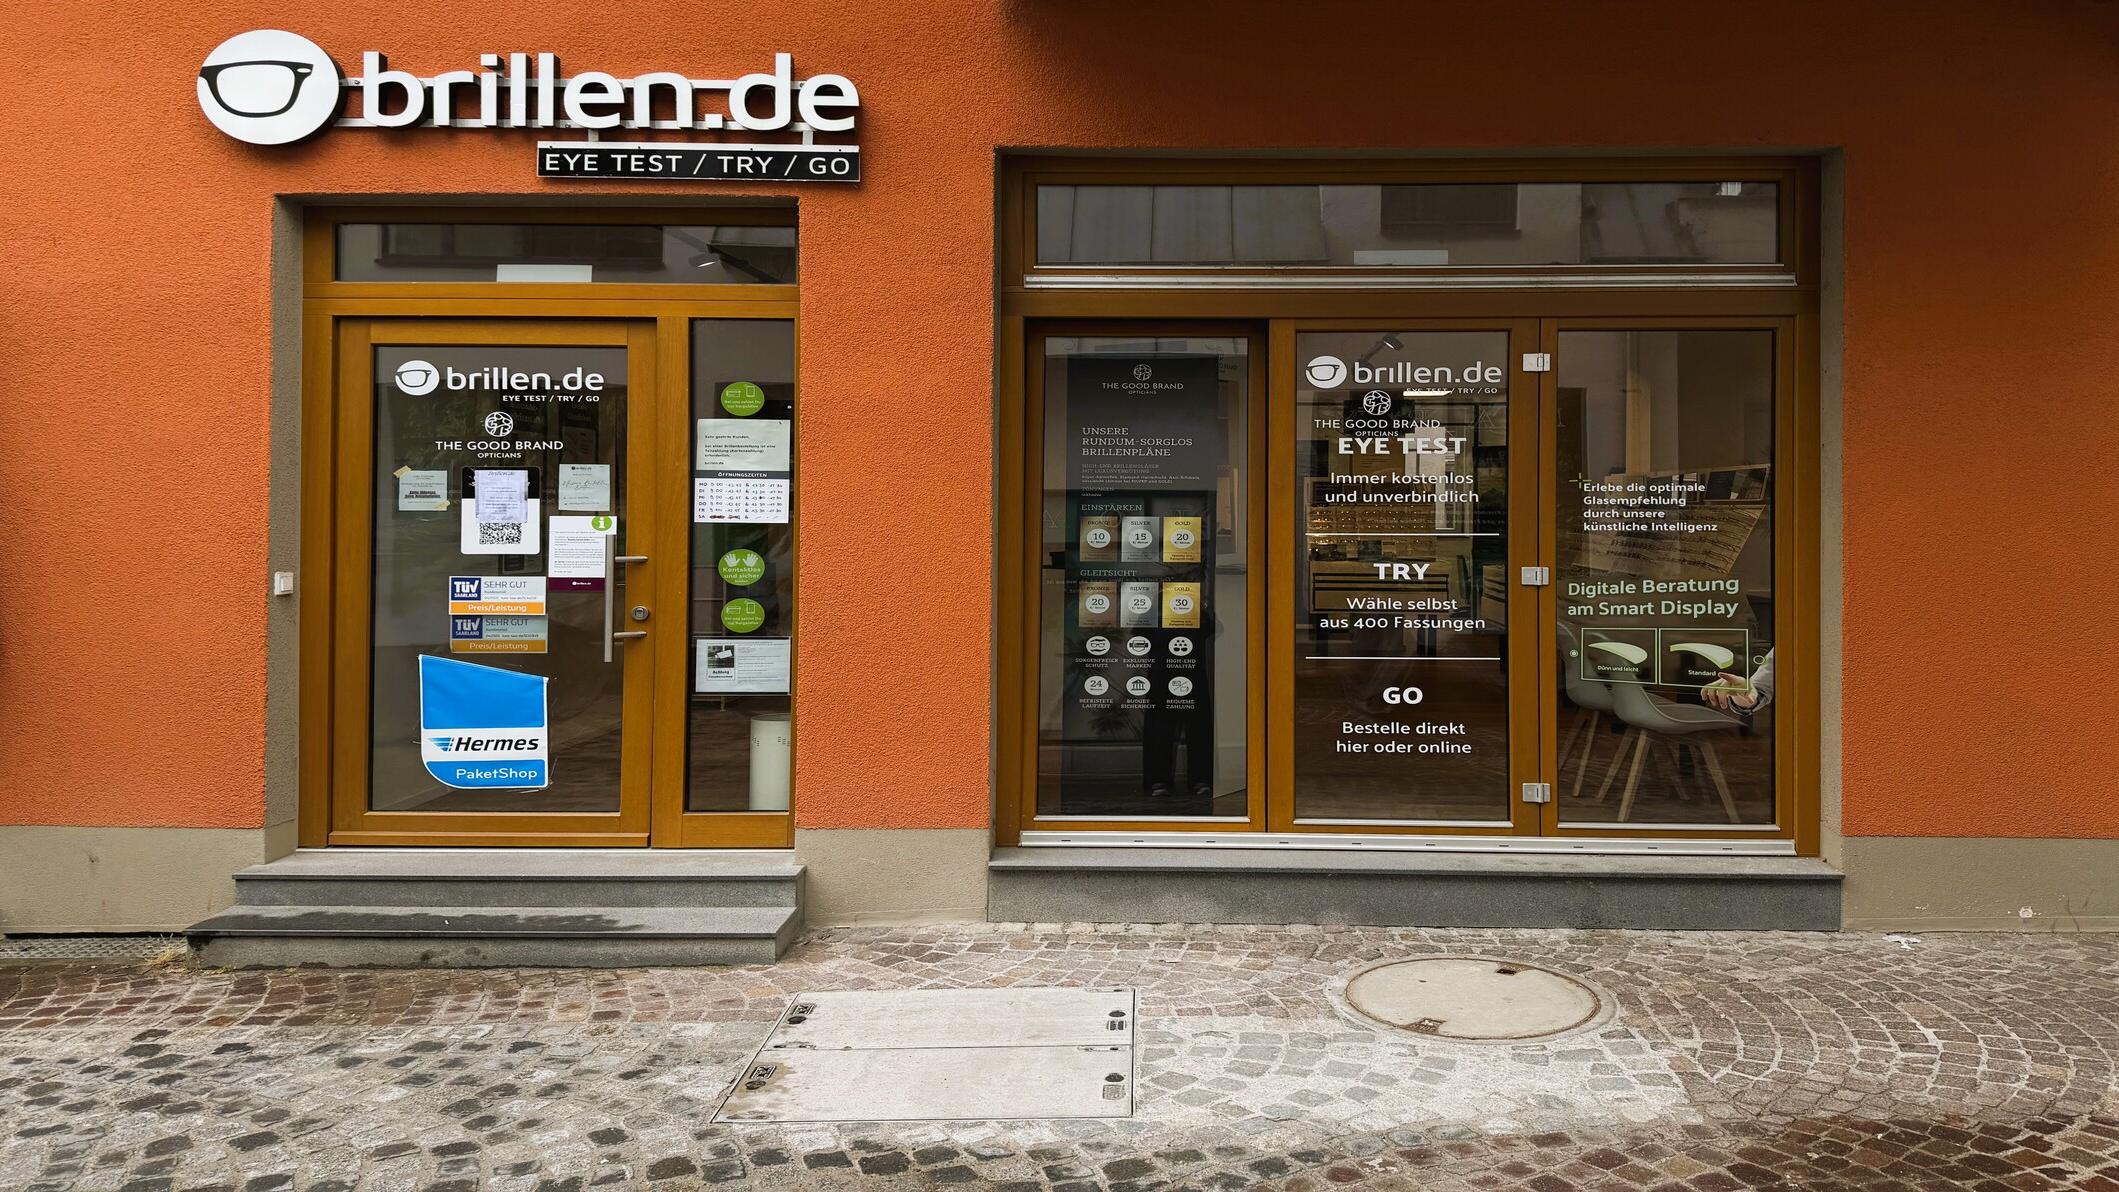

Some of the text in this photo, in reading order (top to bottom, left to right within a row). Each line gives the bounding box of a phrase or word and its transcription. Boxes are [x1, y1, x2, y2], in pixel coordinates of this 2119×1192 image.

[362, 51, 860, 132] brillen.de
[544, 153, 599, 172] EYE
[611, 154, 682, 174] TEST
[717, 155, 773, 175] TRY
[808, 156, 851, 176] GO
[1354, 361, 1502, 384] brillen.de
[447, 367, 605, 391] brillen.de
[1314, 420, 1441, 429] THE GOOD BRAND
[1082, 427, 1129, 435] UNSERE
[435, 441, 564, 450] THE GOOD BRAND
[1082, 438, 1193, 446] RUNDUM-SORGLOS
[1338, 437, 1467, 454] EYE TEST
[1082, 447, 1171, 456] BRILLENPLÄNE
[1331, 472, 1474, 484] Immer kostenlos
[1583, 483, 1706, 494] Erlebe die optimale
[1325, 491, 1479, 503] und unverbindlich
[1583, 496, 1687, 507] Glasempfehlung
[1583, 509, 1665, 518] durch unsere
[1583, 522, 1718, 533] künstliche Intelligenz
[1176, 533, 1189, 541] 20
[1373, 563, 1430, 580] TRY
[454, 580, 479, 593] TÜV
[484, 581, 527, 589] SEHR GUT
[1568, 578, 1740, 597] Digitale Beratung
[1091, 598, 1104, 606] 20
[1133, 598, 1146, 606] 25
[1346, 598, 1458, 610] Wähle selbst
[468, 604, 527, 613] Preis/Leistung
[1567, 600, 1739, 618] am Smart Display
[455, 618, 480, 631] TÜV
[1320, 617, 1486, 631] aus 400 Fassungen
[469, 642, 529, 650] Preis/Leistung
[1090, 680, 1102, 688] 24
[1382, 687, 1424, 705] GO
[1342, 722, 1466, 735] Bestelle direkt
[454, 736, 539, 752] Hermes
[1336, 741, 1472, 754] hier oder online
[456, 768, 538, 780] PaketShop
